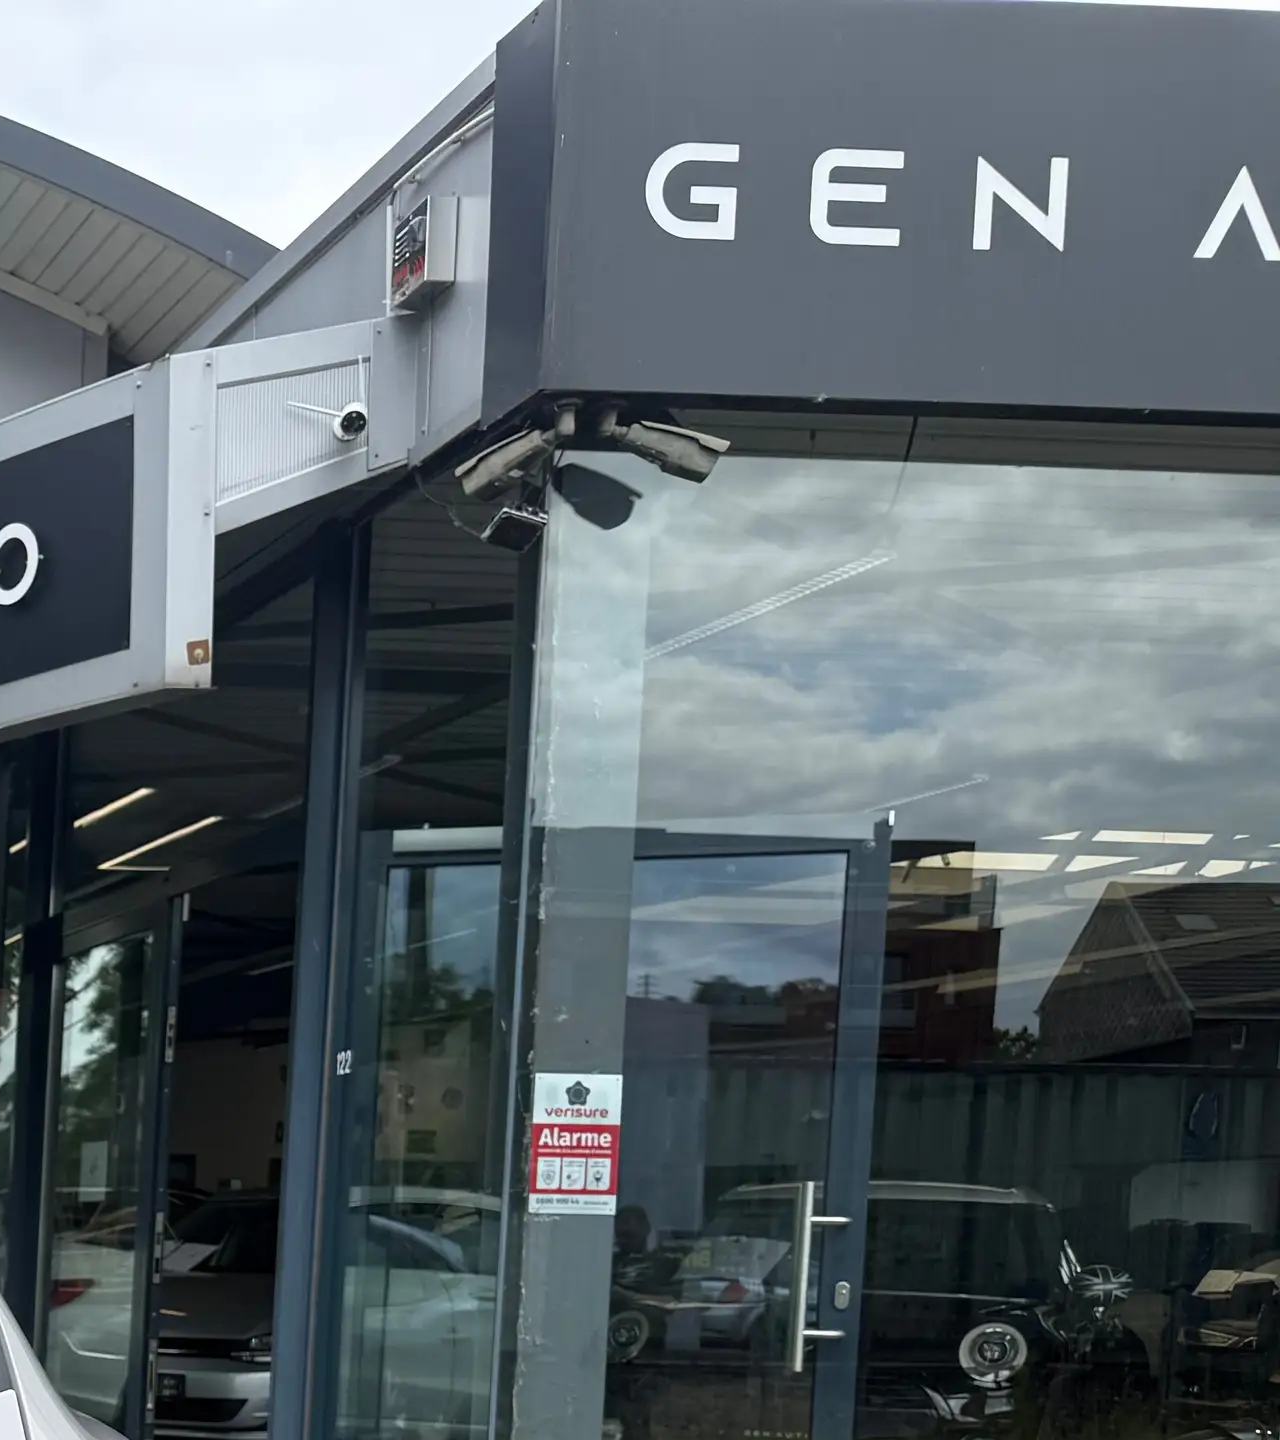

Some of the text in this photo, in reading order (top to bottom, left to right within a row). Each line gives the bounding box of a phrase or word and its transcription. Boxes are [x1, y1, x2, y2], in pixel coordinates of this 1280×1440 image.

[645, 142, 1069, 252] GEN
[336, 1049, 352, 1075] 122
[545, 1106, 609, 1119] verisure
[538, 1127, 612, 1148] Alarme
